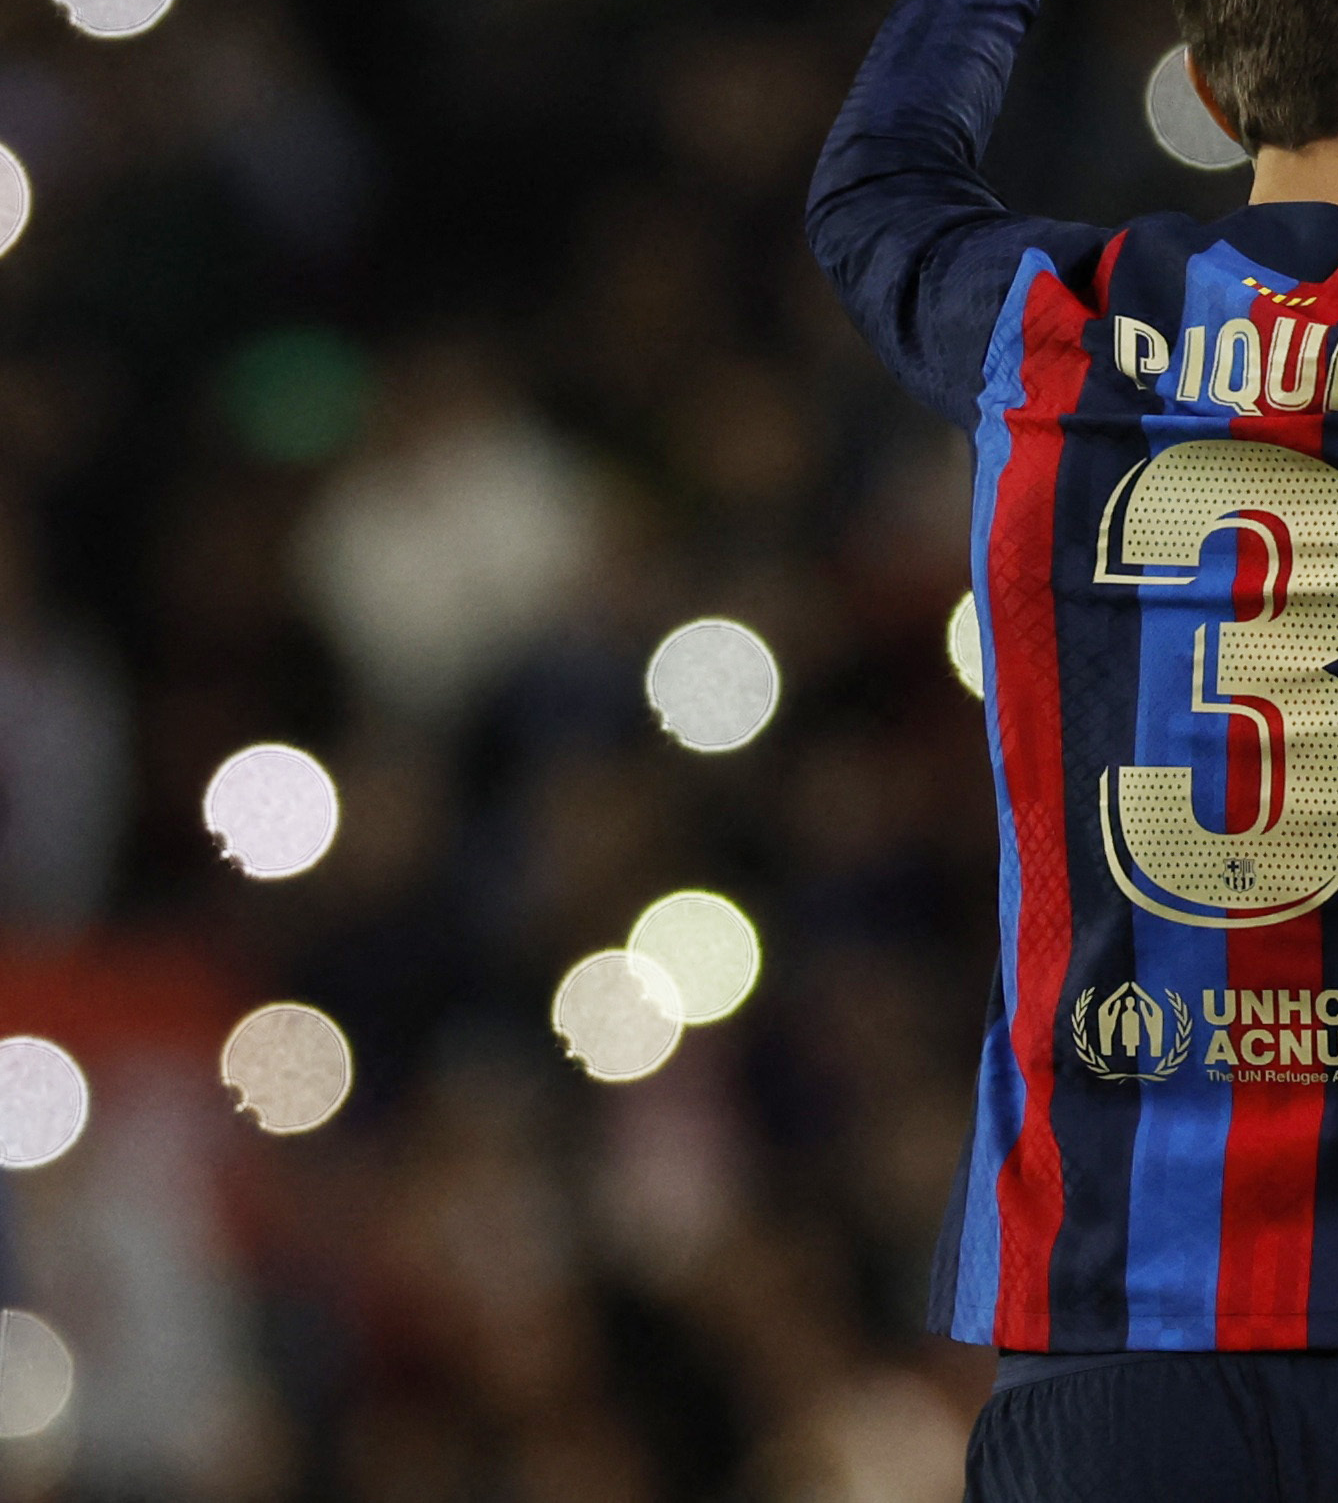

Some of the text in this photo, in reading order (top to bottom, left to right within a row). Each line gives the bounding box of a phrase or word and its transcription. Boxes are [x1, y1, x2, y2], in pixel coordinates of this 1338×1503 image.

[1206, 1069, 1235, 1083] The
[1238, 1069, 1262, 1083] UN
[1265, 1069, 1329, 1086] Refugee
